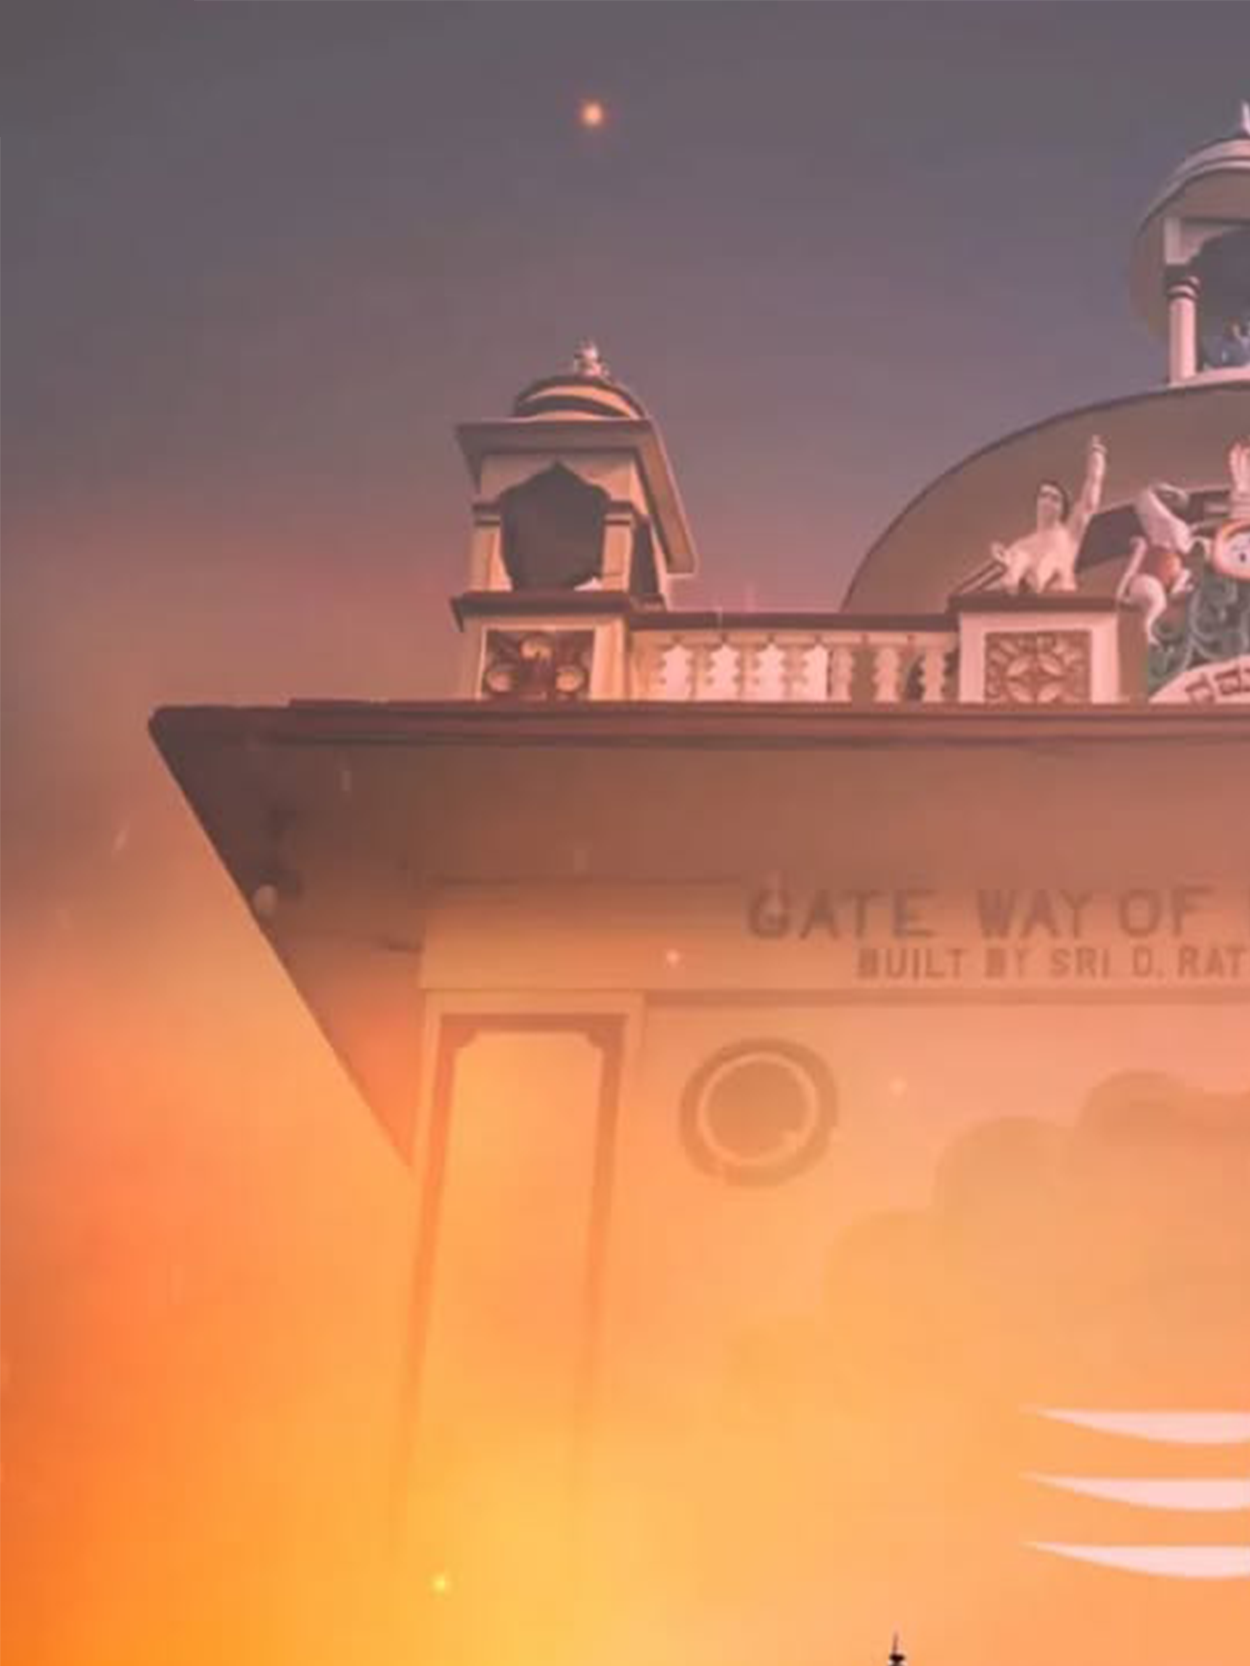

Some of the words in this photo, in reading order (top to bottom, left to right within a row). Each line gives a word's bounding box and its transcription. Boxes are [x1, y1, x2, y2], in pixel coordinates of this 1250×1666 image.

[748, 886, 938, 940] GATE
[976, 886, 1094, 940] WAY
[1117, 883, 1216, 938] OF
[857, 946, 970, 981] BUILT
[984, 946, 1034, 980] BY
[1050, 946, 1111, 979] SRI
